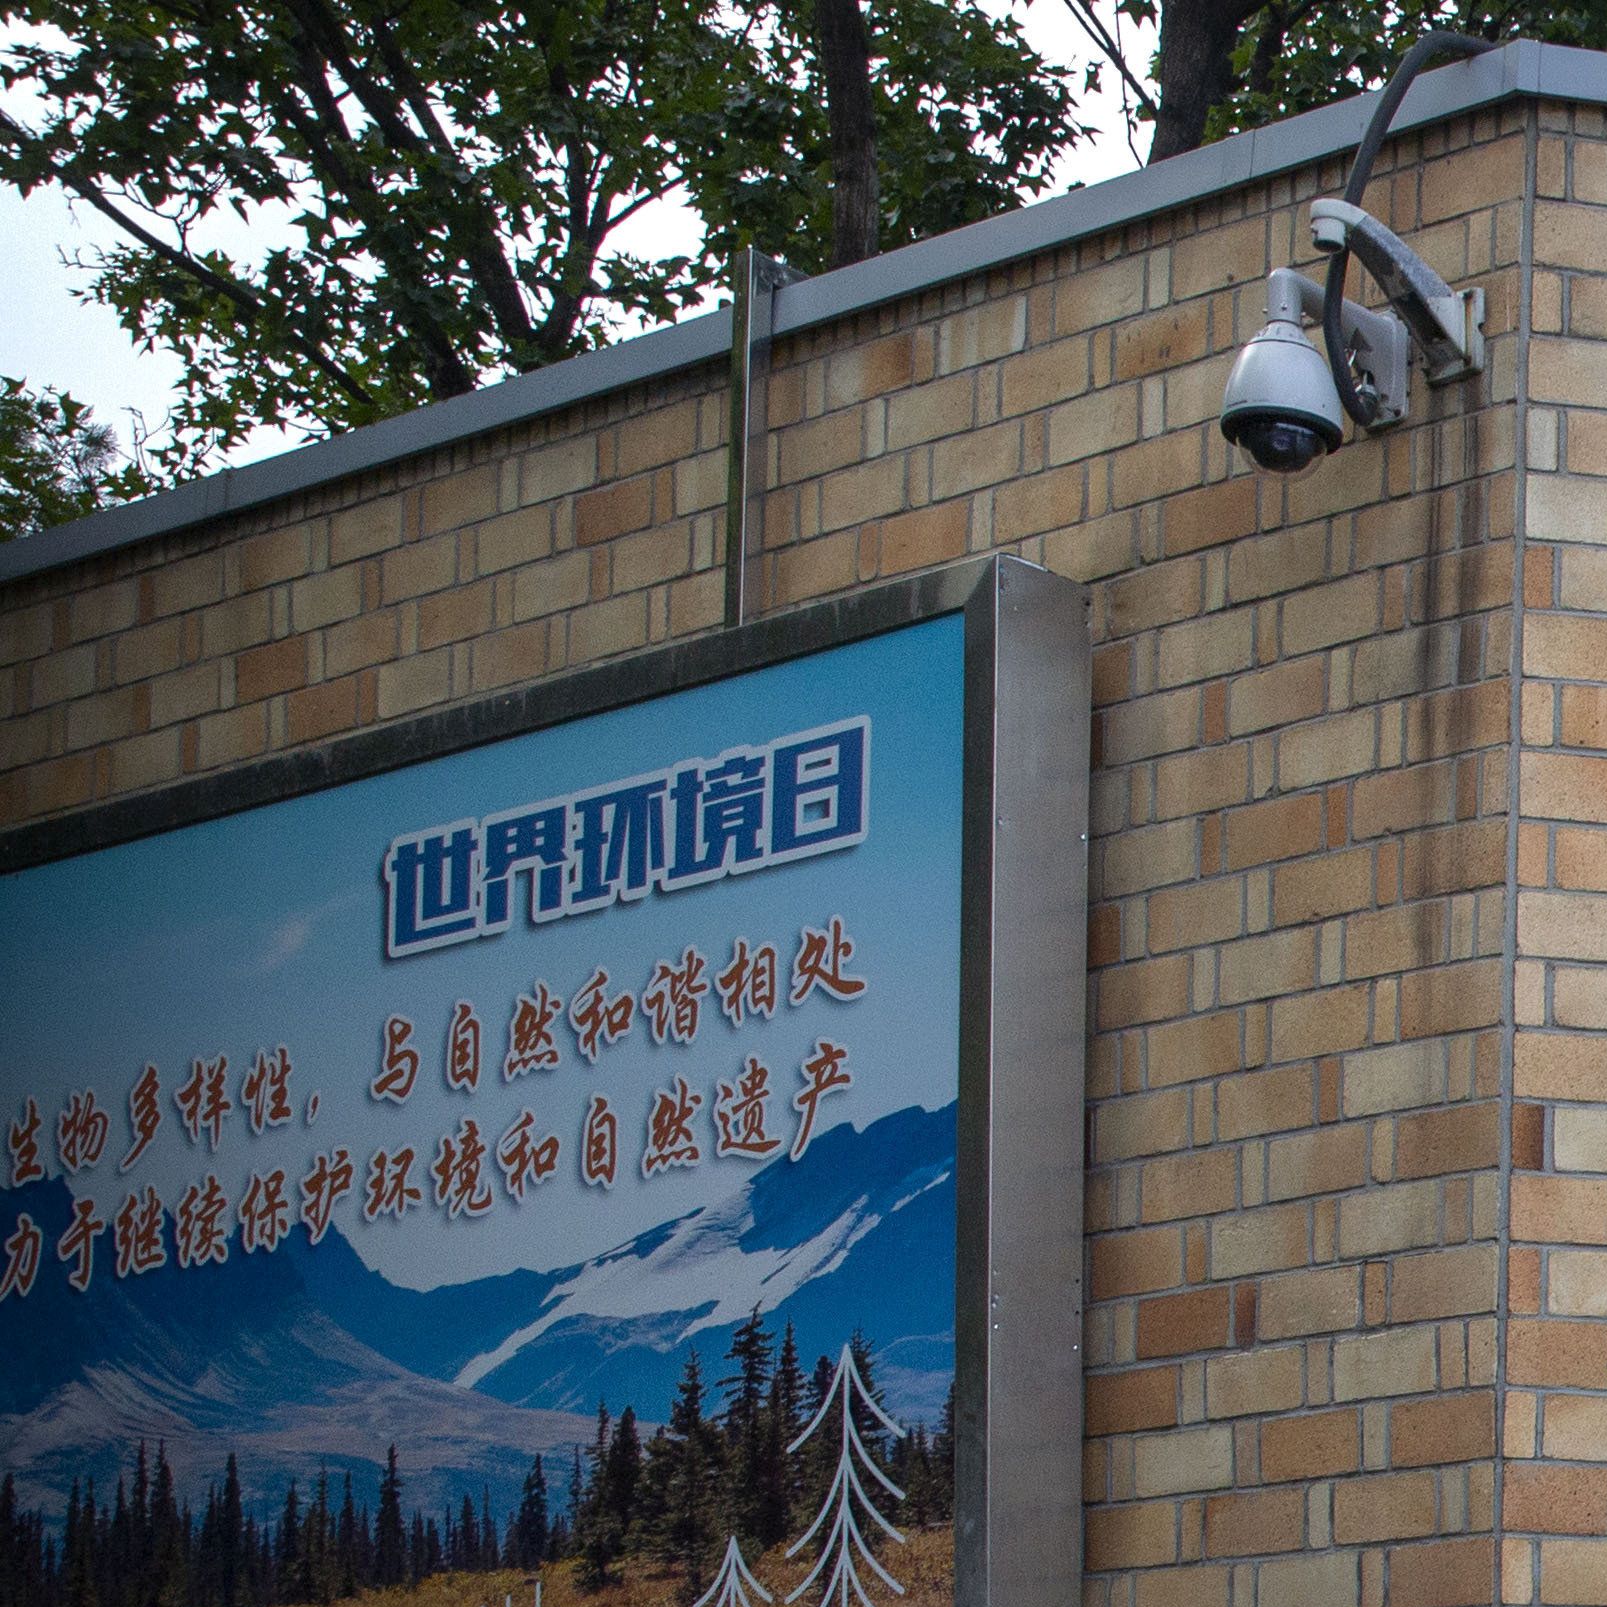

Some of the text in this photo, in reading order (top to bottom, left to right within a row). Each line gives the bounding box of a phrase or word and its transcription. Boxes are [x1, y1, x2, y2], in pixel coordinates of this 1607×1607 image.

[388, 718, 870, 954] 世界环境日
